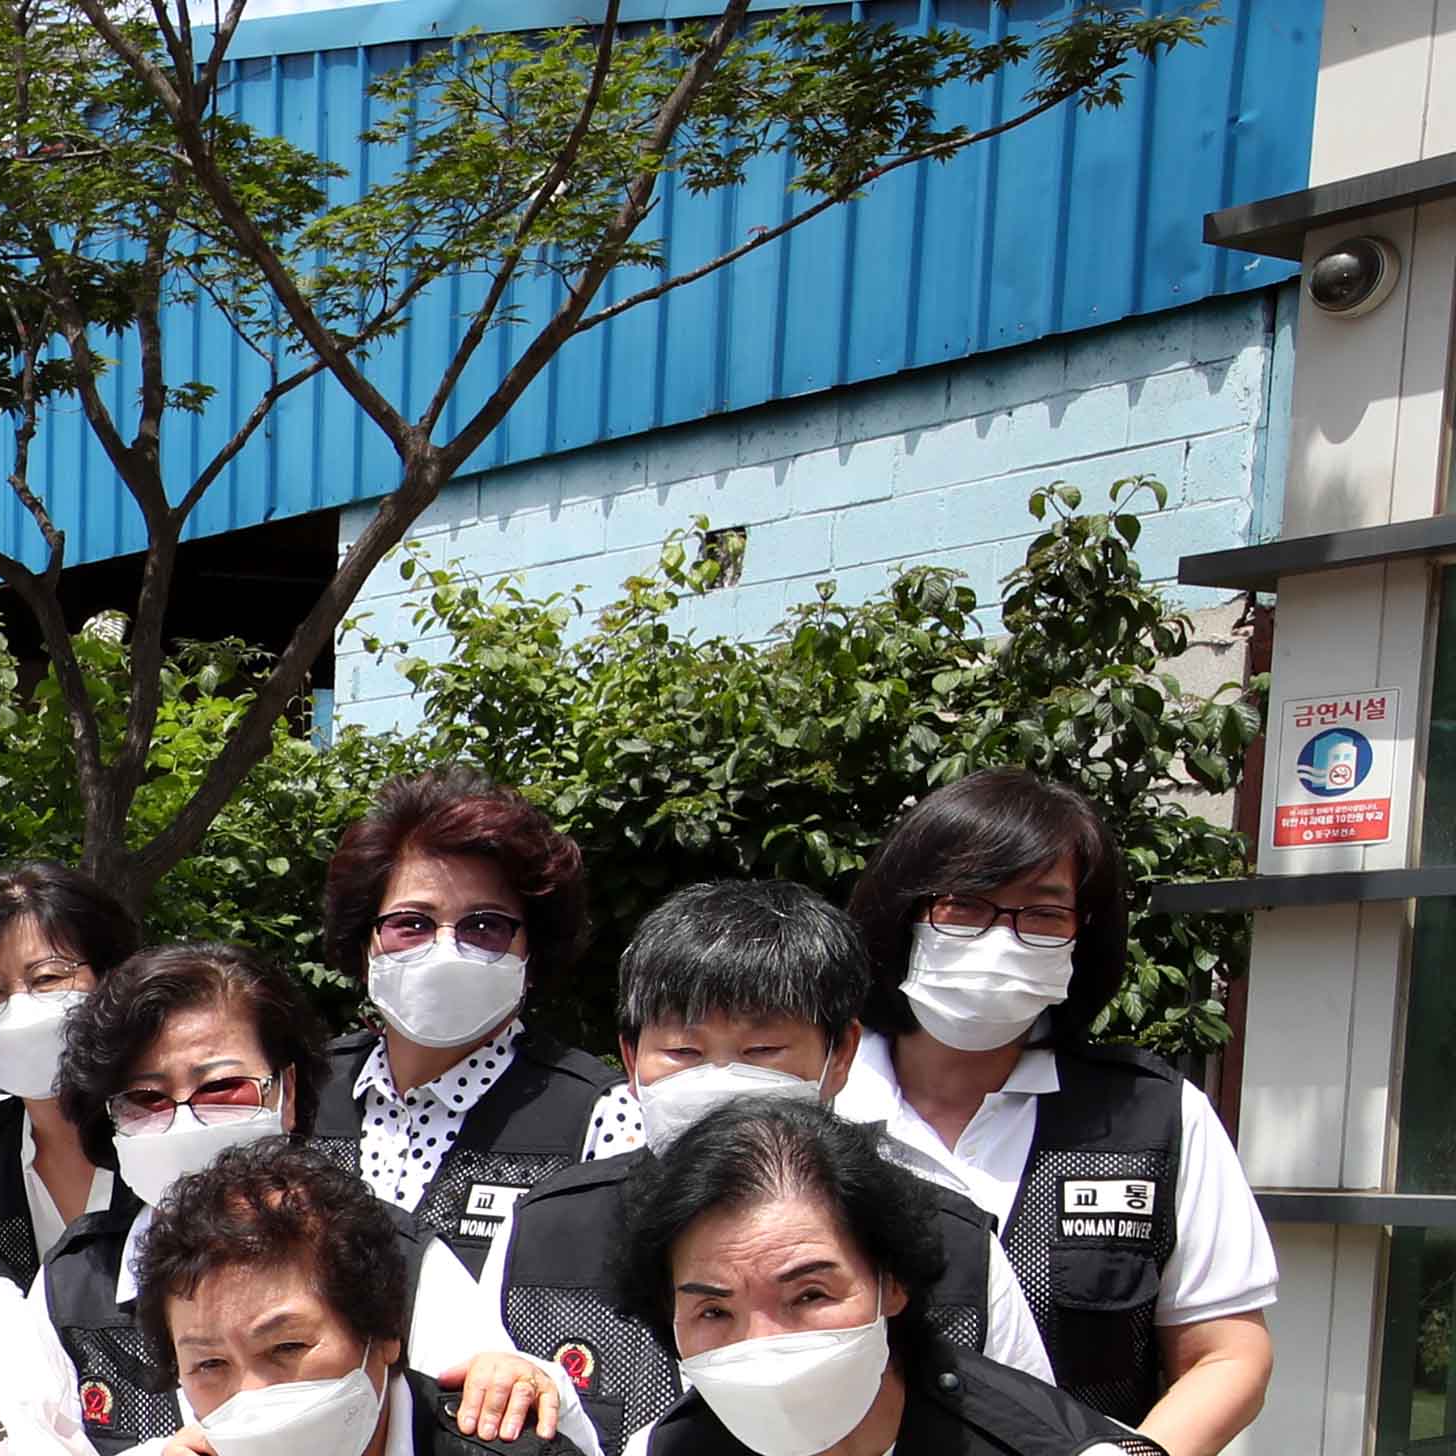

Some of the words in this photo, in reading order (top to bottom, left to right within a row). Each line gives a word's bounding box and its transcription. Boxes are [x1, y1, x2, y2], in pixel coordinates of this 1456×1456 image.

[1293, 697, 1386, 728] 금연시설
[1073, 1184, 1149, 1210] 교통
[1062, 1218, 1116, 1237] WOMAN
[1117, 1219, 1152, 1240] DRIVER
